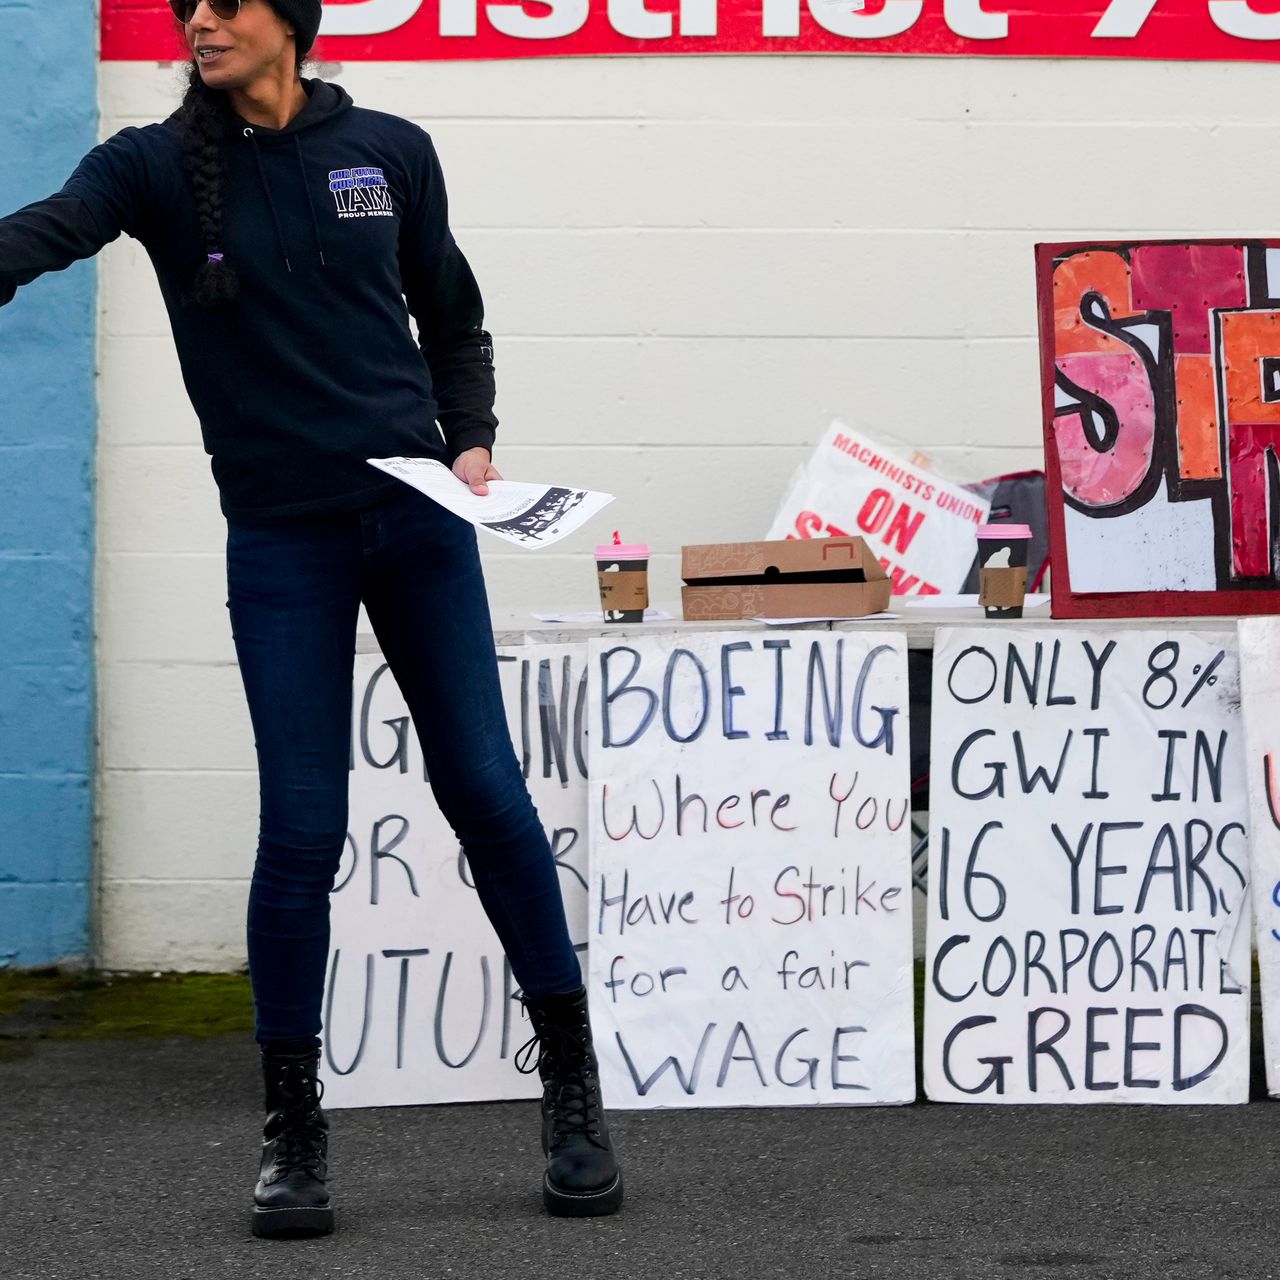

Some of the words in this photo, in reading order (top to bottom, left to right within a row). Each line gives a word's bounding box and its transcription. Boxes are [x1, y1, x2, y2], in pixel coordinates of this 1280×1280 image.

[832, 432, 936, 501] MACHINISTS
[936, 489, 983, 526] UNION
[856, 487, 926, 556] ON
[600, 638, 900, 755] BOEING
[948, 639, 1117, 710] ONLY
[1141, 639, 1226, 709] 8%
[951, 728, 1110, 801] GWI
[1151, 728, 1228, 804] IN
[601, 774, 799, 841] Where
[828, 771, 908, 839] You
[599, 867, 696, 936] Have
[720, 866, 755, 923] to
[771, 865, 902, 927] Strike
[938, 821, 1007, 921] 16
[1050, 819, 1247, 916] YEARS
[604, 954, 688, 1003] for
[723, 965, 750, 992] a
[776, 949, 872, 992] fair
[932, 923, 1244, 1003] CORPORATE
[615, 1021, 871, 1097] WAGE
[942, 1003, 1229, 1095] GREED
